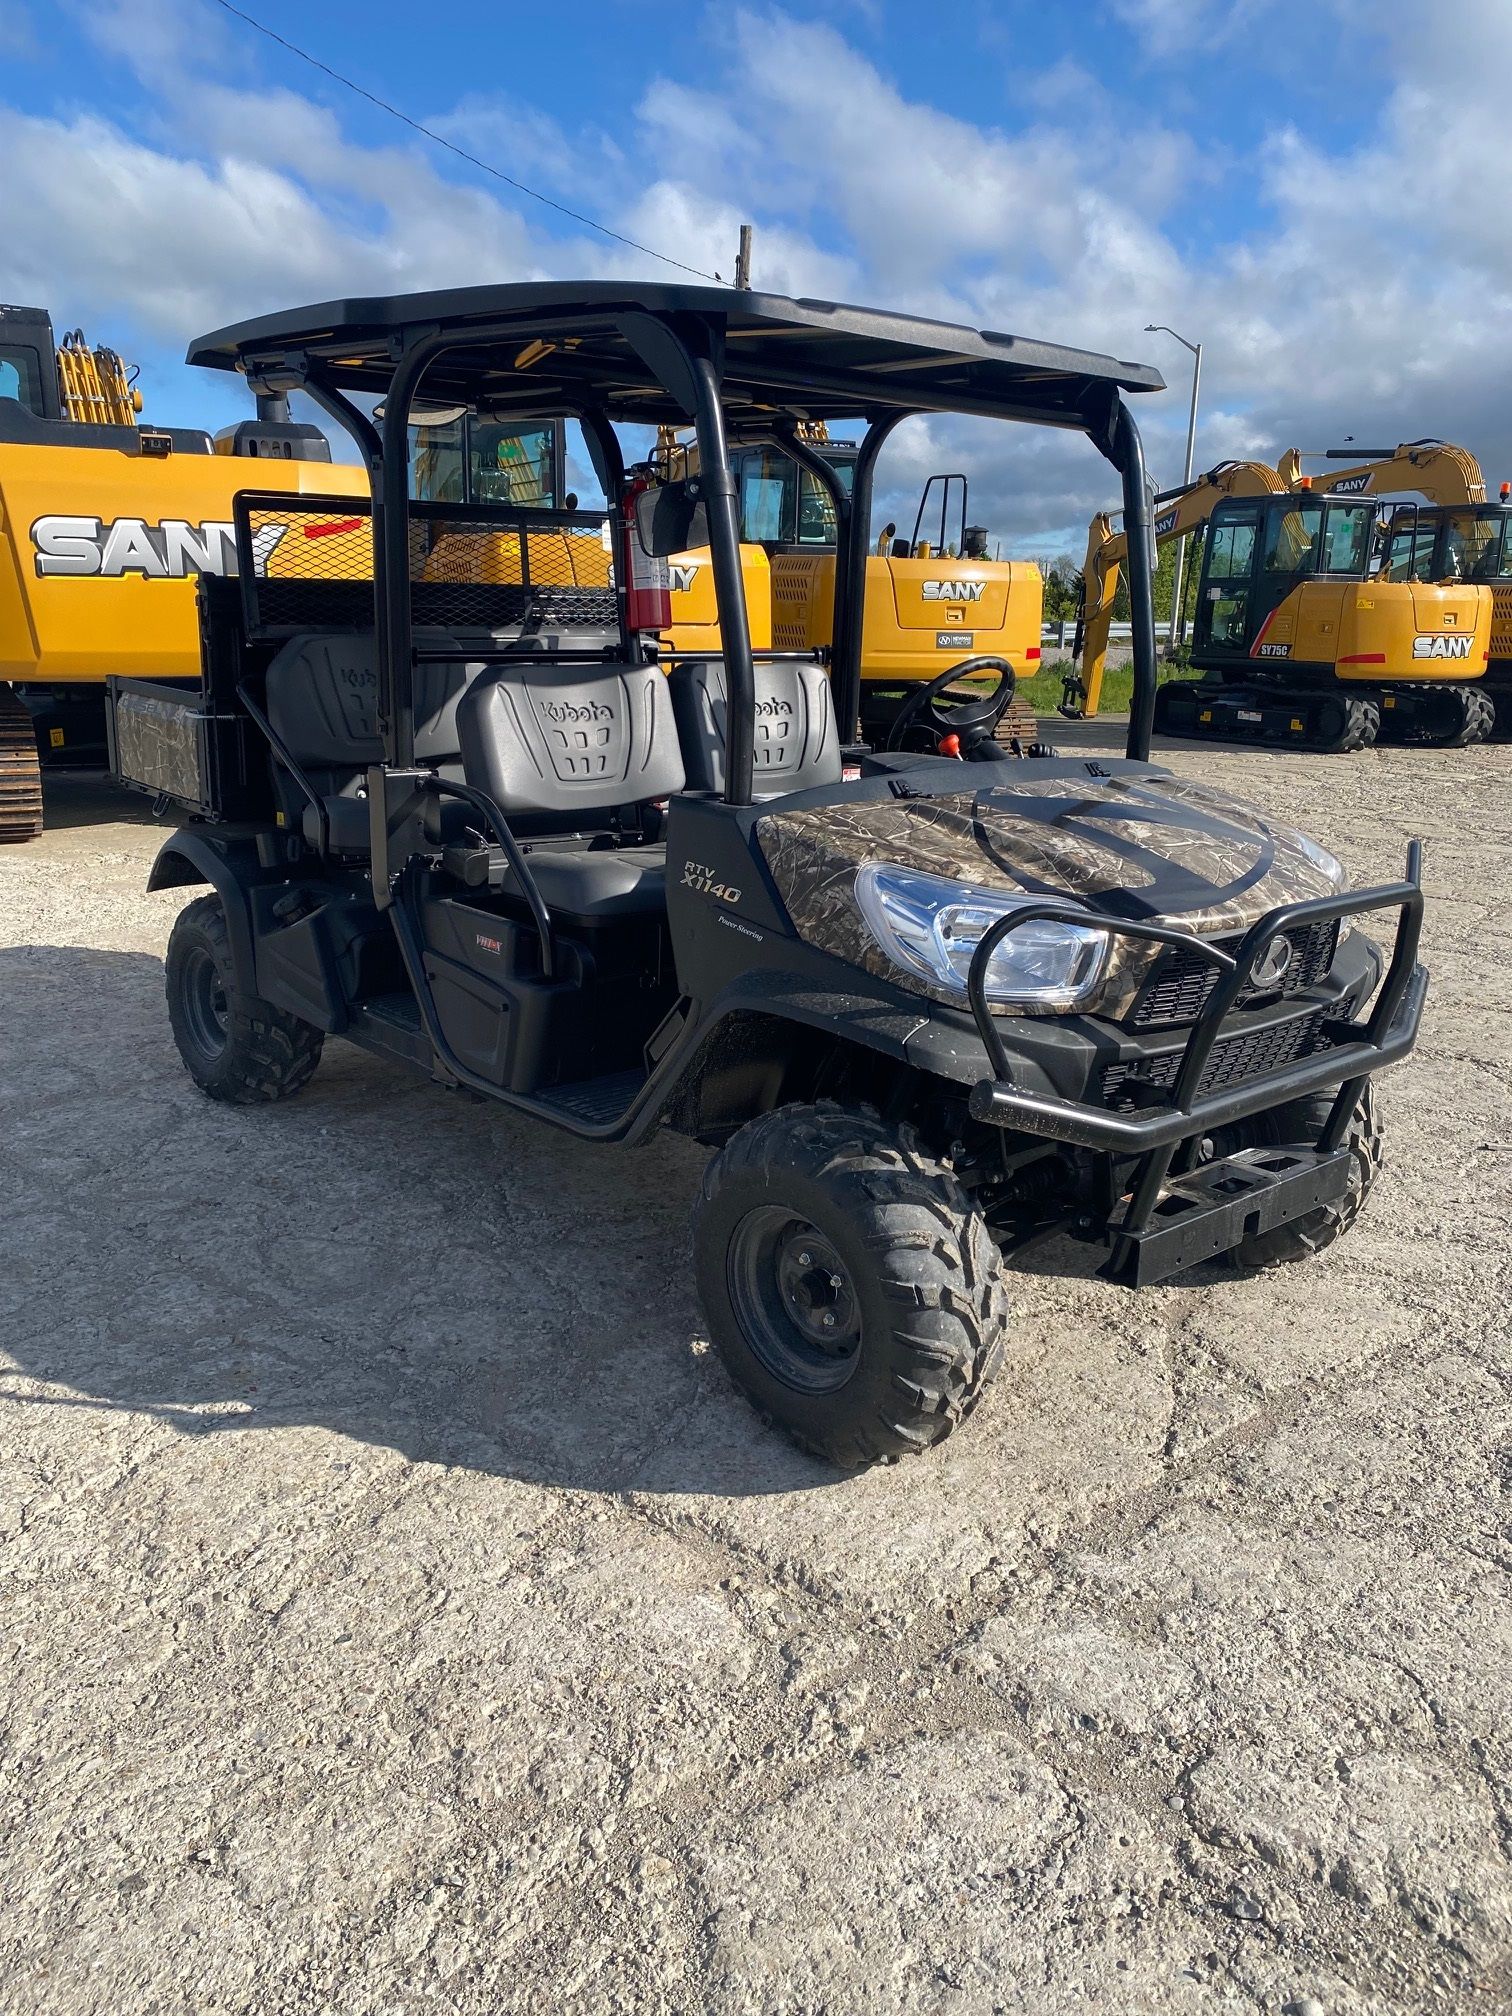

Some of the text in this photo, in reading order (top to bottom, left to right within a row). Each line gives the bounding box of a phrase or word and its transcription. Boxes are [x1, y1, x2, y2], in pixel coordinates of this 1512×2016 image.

[1336, 479, 1366, 492] SANY
[1154, 516, 1173, 533] ANY
[29, 515, 290, 579] SANY
[922, 581, 987, 601] SANY
[1261, 644, 1288, 656] SY75C
[1413, 636, 1476, 659] SANY
[341, 668, 377, 688] Kub
[540, 701, 614, 722] Kubota
[684, 861, 716, 878] RTV
[680, 871, 742, 903] X1140
[718, 915, 764, 942] Power Steering
